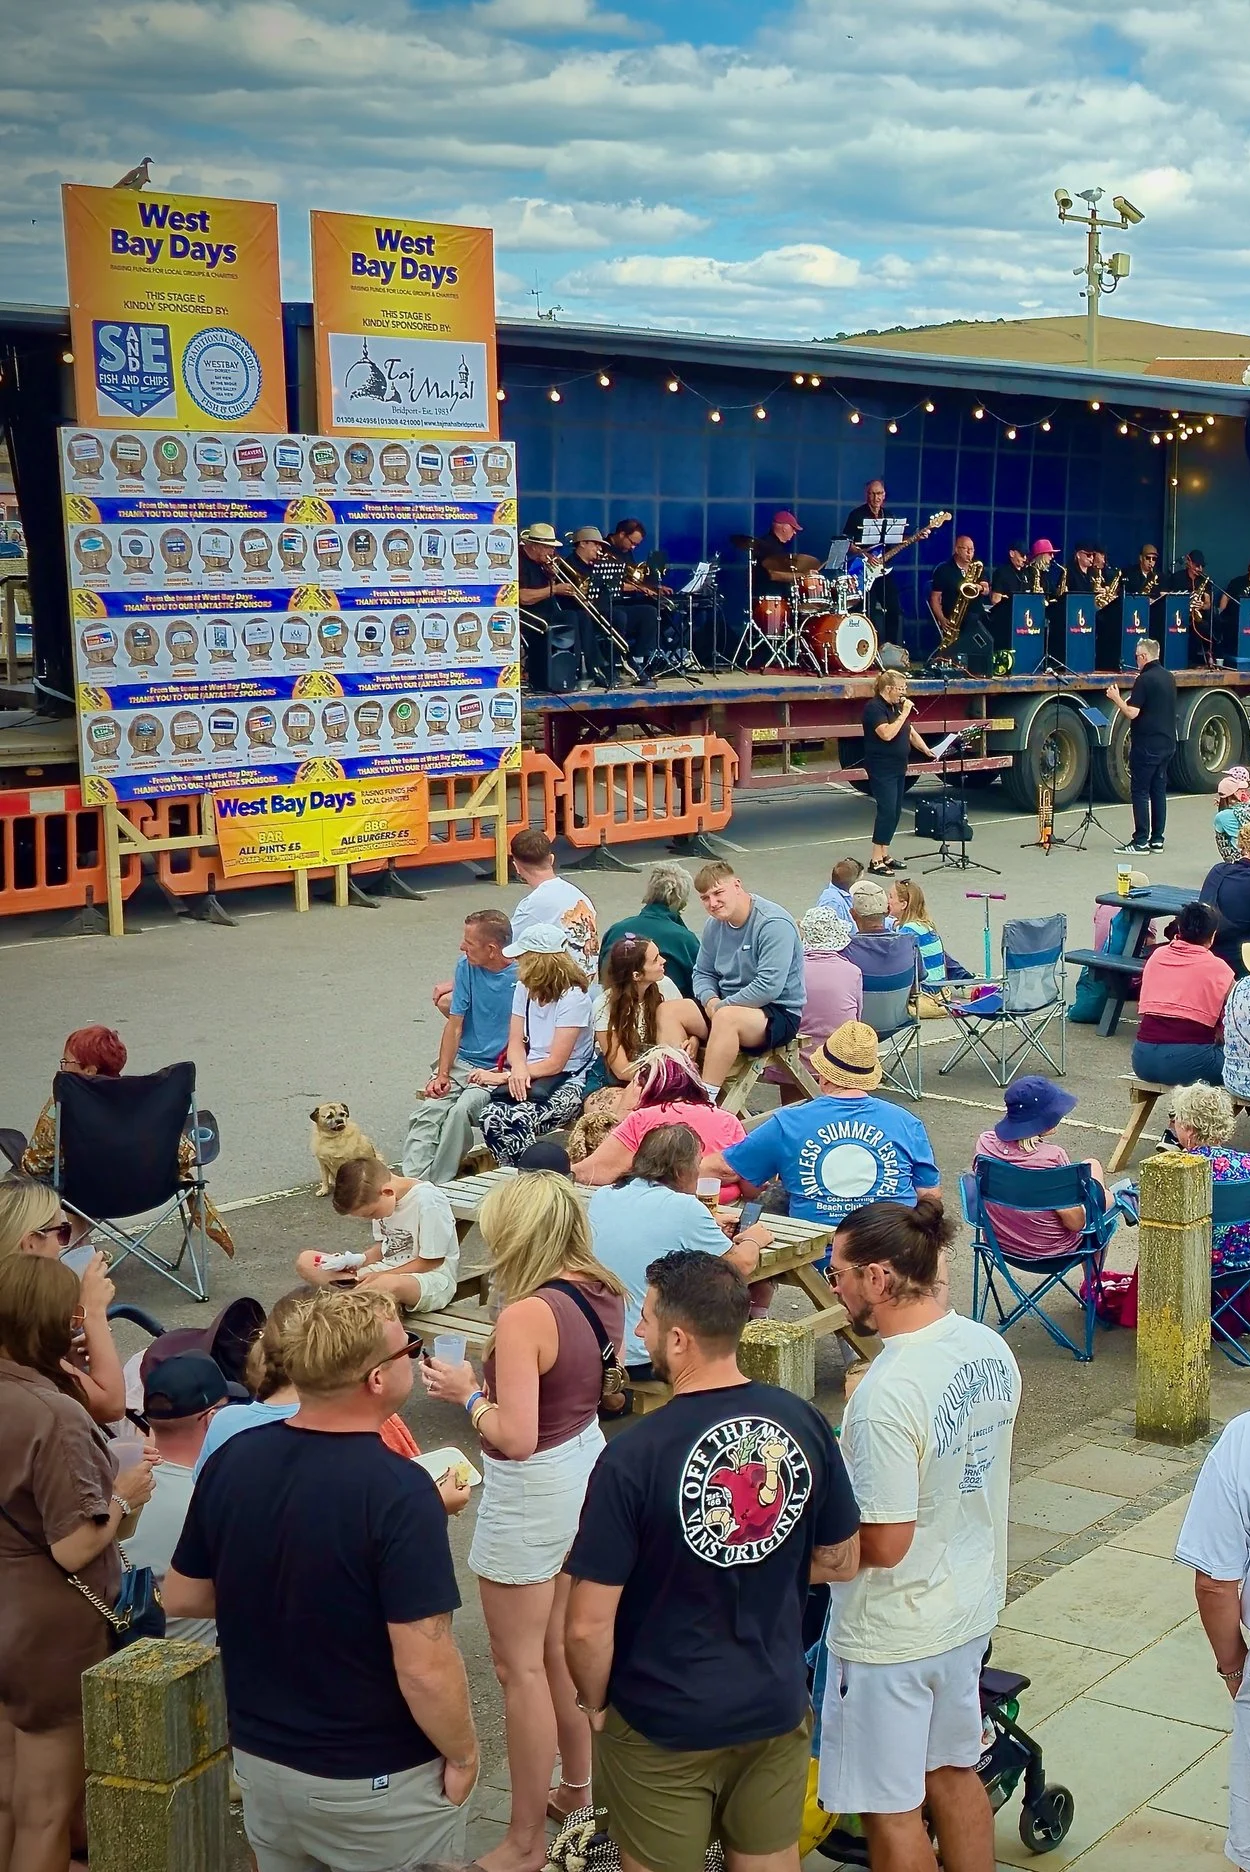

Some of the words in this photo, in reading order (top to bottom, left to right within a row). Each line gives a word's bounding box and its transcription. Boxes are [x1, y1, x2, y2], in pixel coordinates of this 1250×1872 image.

[138, 202, 211, 233] West
[110, 228, 164, 264] Bay
[169, 233, 238, 269] Days
[375, 228, 436, 256] West
[352, 252, 396, 285] Bay
[400, 256, 459, 290] Days
[145, 291, 165, 301] THIS
[167, 292, 196, 303] STAGE
[197, 294, 206, 304] IS
[124, 300, 156, 311] KINDLY
[158, 302, 214, 314] SPONSORED
[216, 306, 229, 316] BY:
[381, 310, 398, 318] THIS
[400, 311, 423, 320] STAGE
[363, 318, 390, 328] KINDLY
[392, 320, 438, 332] SPONSORED
[440, 324, 452, 333] BY:
[99, 325, 126, 372] S
[126, 326, 140, 372] AND
[140, 327, 167, 373] E
[188, 333, 229, 368] TRADITIONAL
[230, 336, 256, 372] SEASIDE
[100, 374, 118, 384] FISH
[122, 374, 140, 385] AND
[144, 376, 169, 386] CHIPS
[384, 358, 415, 392] Taj
[411, 377, 474, 412] Mahal
[202, 397, 219, 412] FISH
[228, 400, 250, 414] CHIPS
[231, 503, 248, 511] Days
[124, 604, 150, 612] THANK
[195, 602, 233, 610] FANTASTIC
[234, 600, 272, 609] SPONSORS
[133, 786, 158, 795] THANK
[158, 785, 174, 794] YOU
[174, 784, 186, 792] TO
[187, 782, 205, 791] OUR
[206, 778, 242, 790] FANTASTIC
[242, 776, 278, 787] SPONSORS
[361, 789, 384, 797] RAISING
[385, 787, 406, 796] FUNDS
[216, 798, 268, 818] West
[270, 795, 308, 818] Bay
[310, 790, 356, 814] Days
[382, 795, 410, 804] CHARITIES
[364, 820, 388, 832] BBQ
[258, 831, 282, 844] BAR
[340, 836, 356, 846] ALL
[357, 832, 396, 844] BURGERS
[397, 830, 410, 838] £5
[239, 846, 258, 856] ALL
[259, 844, 286, 854] PINTS
[288, 842, 302, 852] £5
[817, 1120, 884, 1146] SUMMER
[877, 1141, 900, 1197] ESCAPES
[816, 1202, 842, 1211] Beach
[972, 1426, 994, 1438] ANGELES
[684, 1448, 710, 1499] OFF
[708, 1421, 752, 1450] THE
[757, 1423, 805, 1478] WALL
[686, 1508, 722, 1558] VANS
[725, 1488, 807, 1563] ORIGINAL
